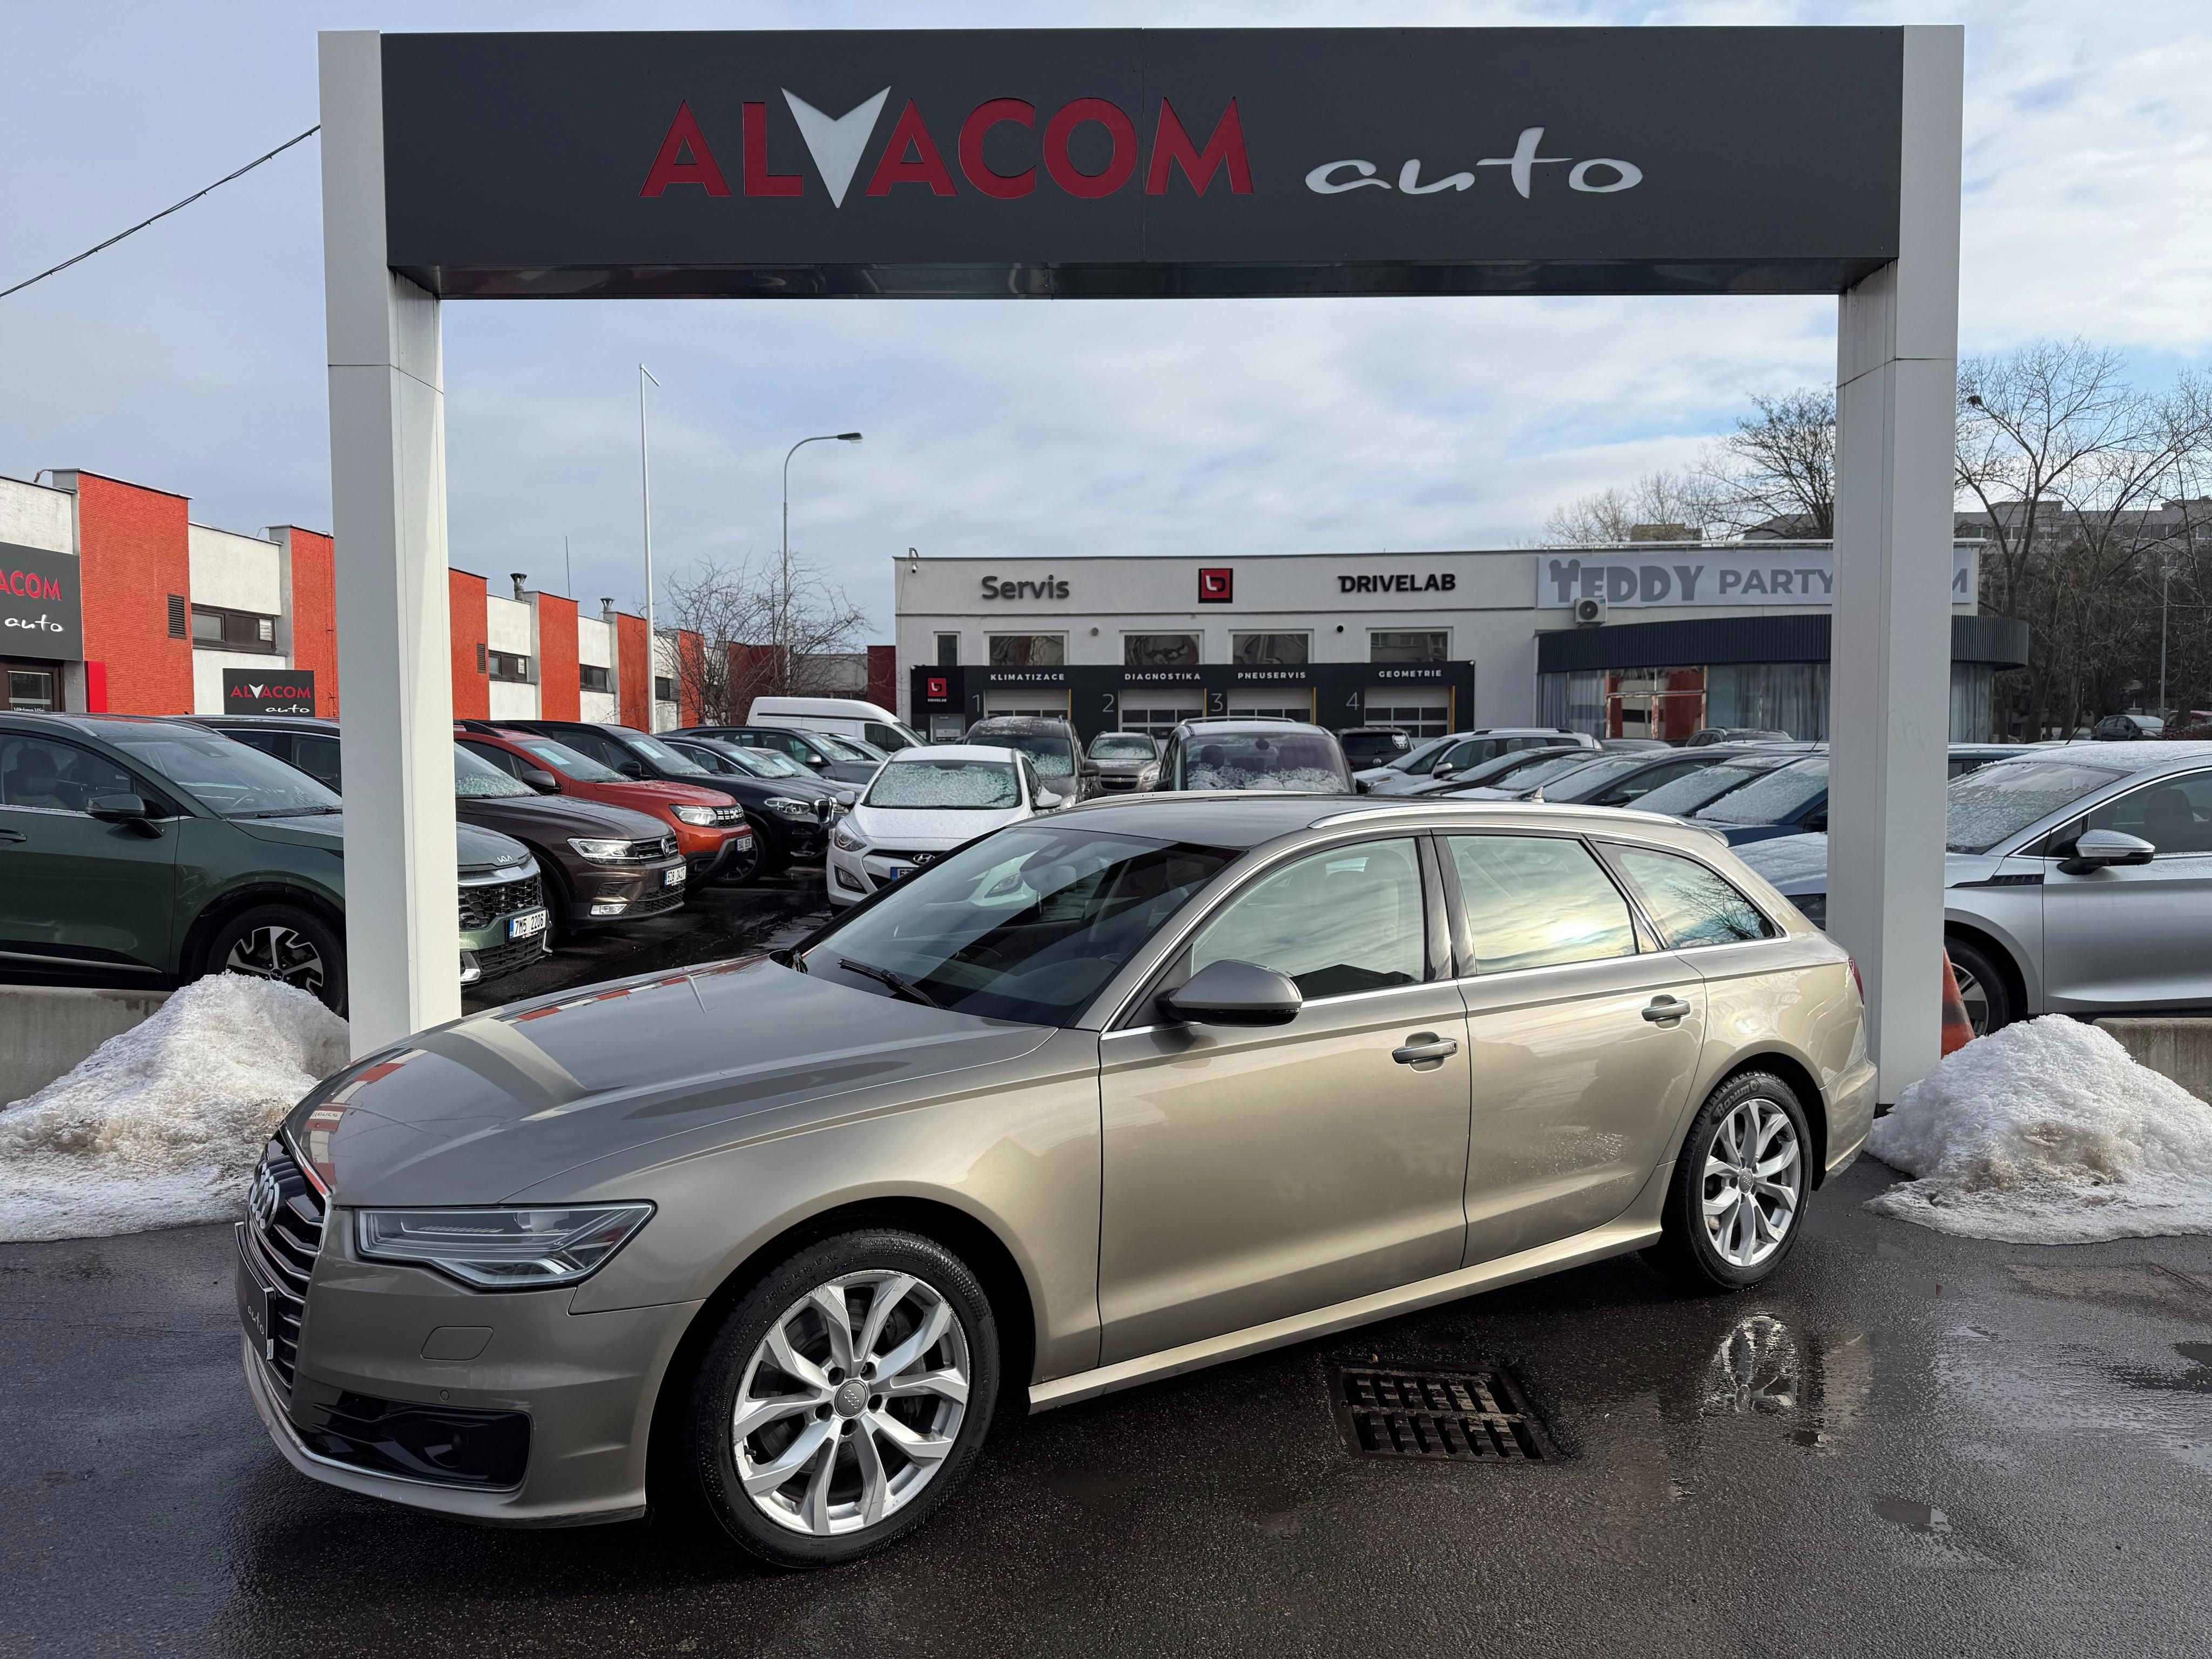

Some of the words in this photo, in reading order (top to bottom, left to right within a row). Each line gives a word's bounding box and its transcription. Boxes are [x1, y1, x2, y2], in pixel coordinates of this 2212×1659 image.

[638, 85, 1255, 208] ALVACOM
[1305, 125, 1643, 199] auto
[981, 575, 1070, 599] Servis
[1337, 574, 1456, 593] DRIVELAB
[1549, 559, 1704, 602] TEDDY
[1719, 569, 1833, 594] PARTY
[4, 614, 64, 632] auto
[1379, 670, 1442, 678] GEOMETRIE
[230, 683, 312, 699] ALVACOM
[265, 704, 310, 713] auto
[972, 694, 980, 712] 1
[1102, 694, 1114, 712] 2
[1211, 693, 1223, 712] 3
[1346, 692, 1360, 710] 4
[515, 918, 527, 935] 7M5
[531, 913, 544, 930] 2206
[1713, 1084, 1750, 1117] Barum
[248, 1305, 265, 1335] auto
